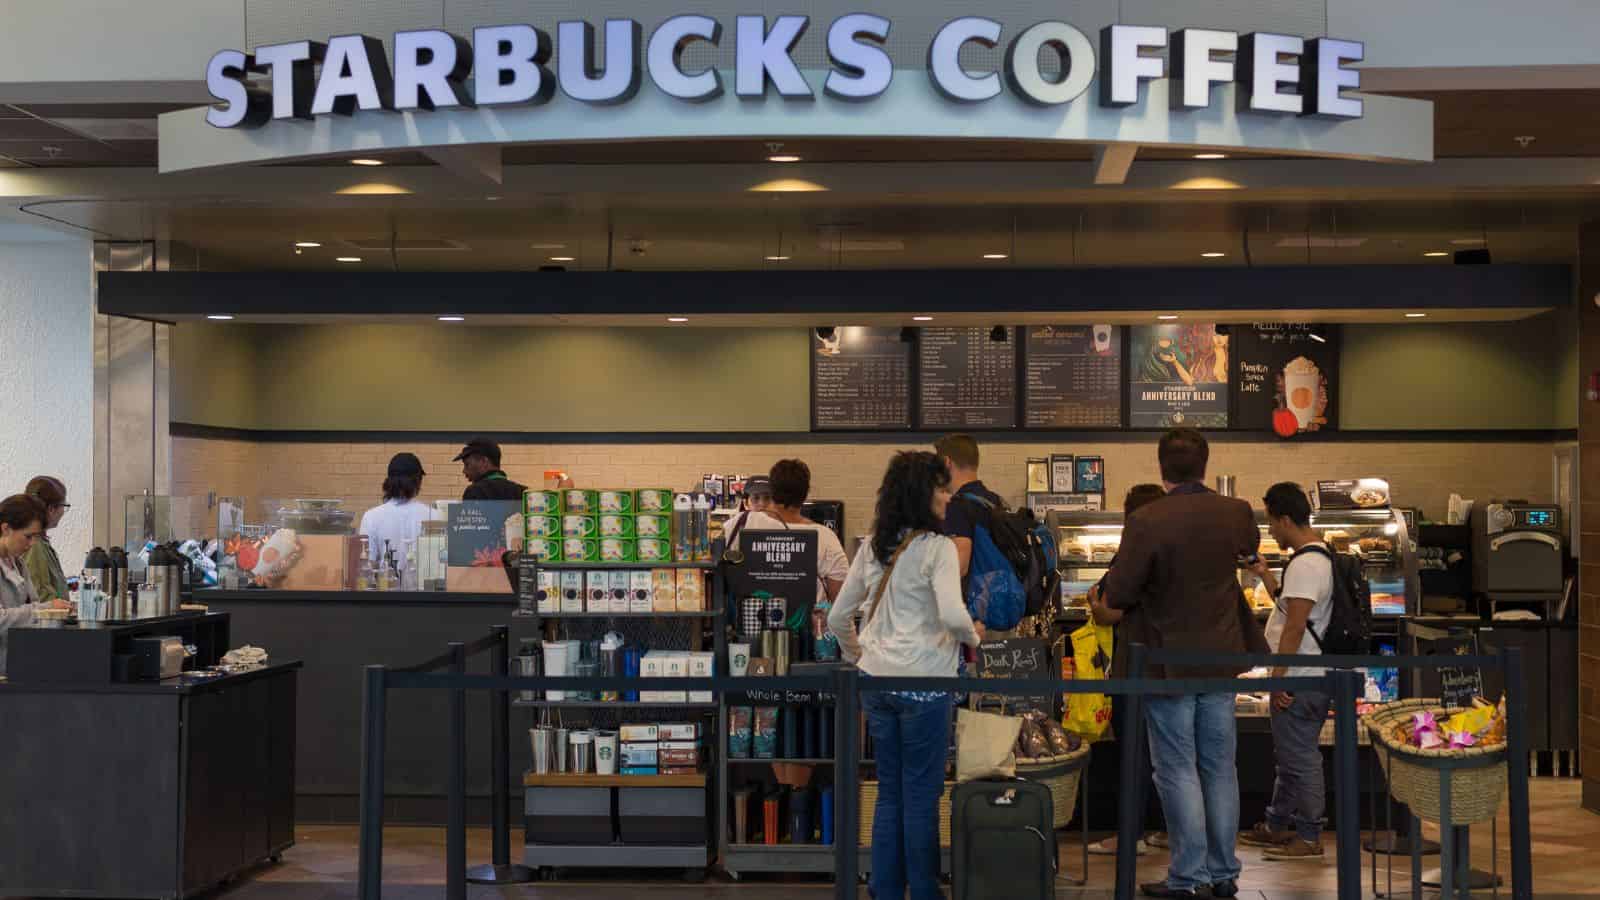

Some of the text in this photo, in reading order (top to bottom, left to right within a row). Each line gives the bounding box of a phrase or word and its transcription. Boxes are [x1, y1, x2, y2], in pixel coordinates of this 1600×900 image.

[205, 13, 1364, 128] STARBUCKS COFFEE
[1141, 391, 1216, 401] ANNIVERSARY BLEND
[752, 541, 806, 552] ANNIVERSARY
[765, 552, 792, 562] BLEND
[746, 689, 781, 701] Whole
[785, 689, 811, 703] Bean
